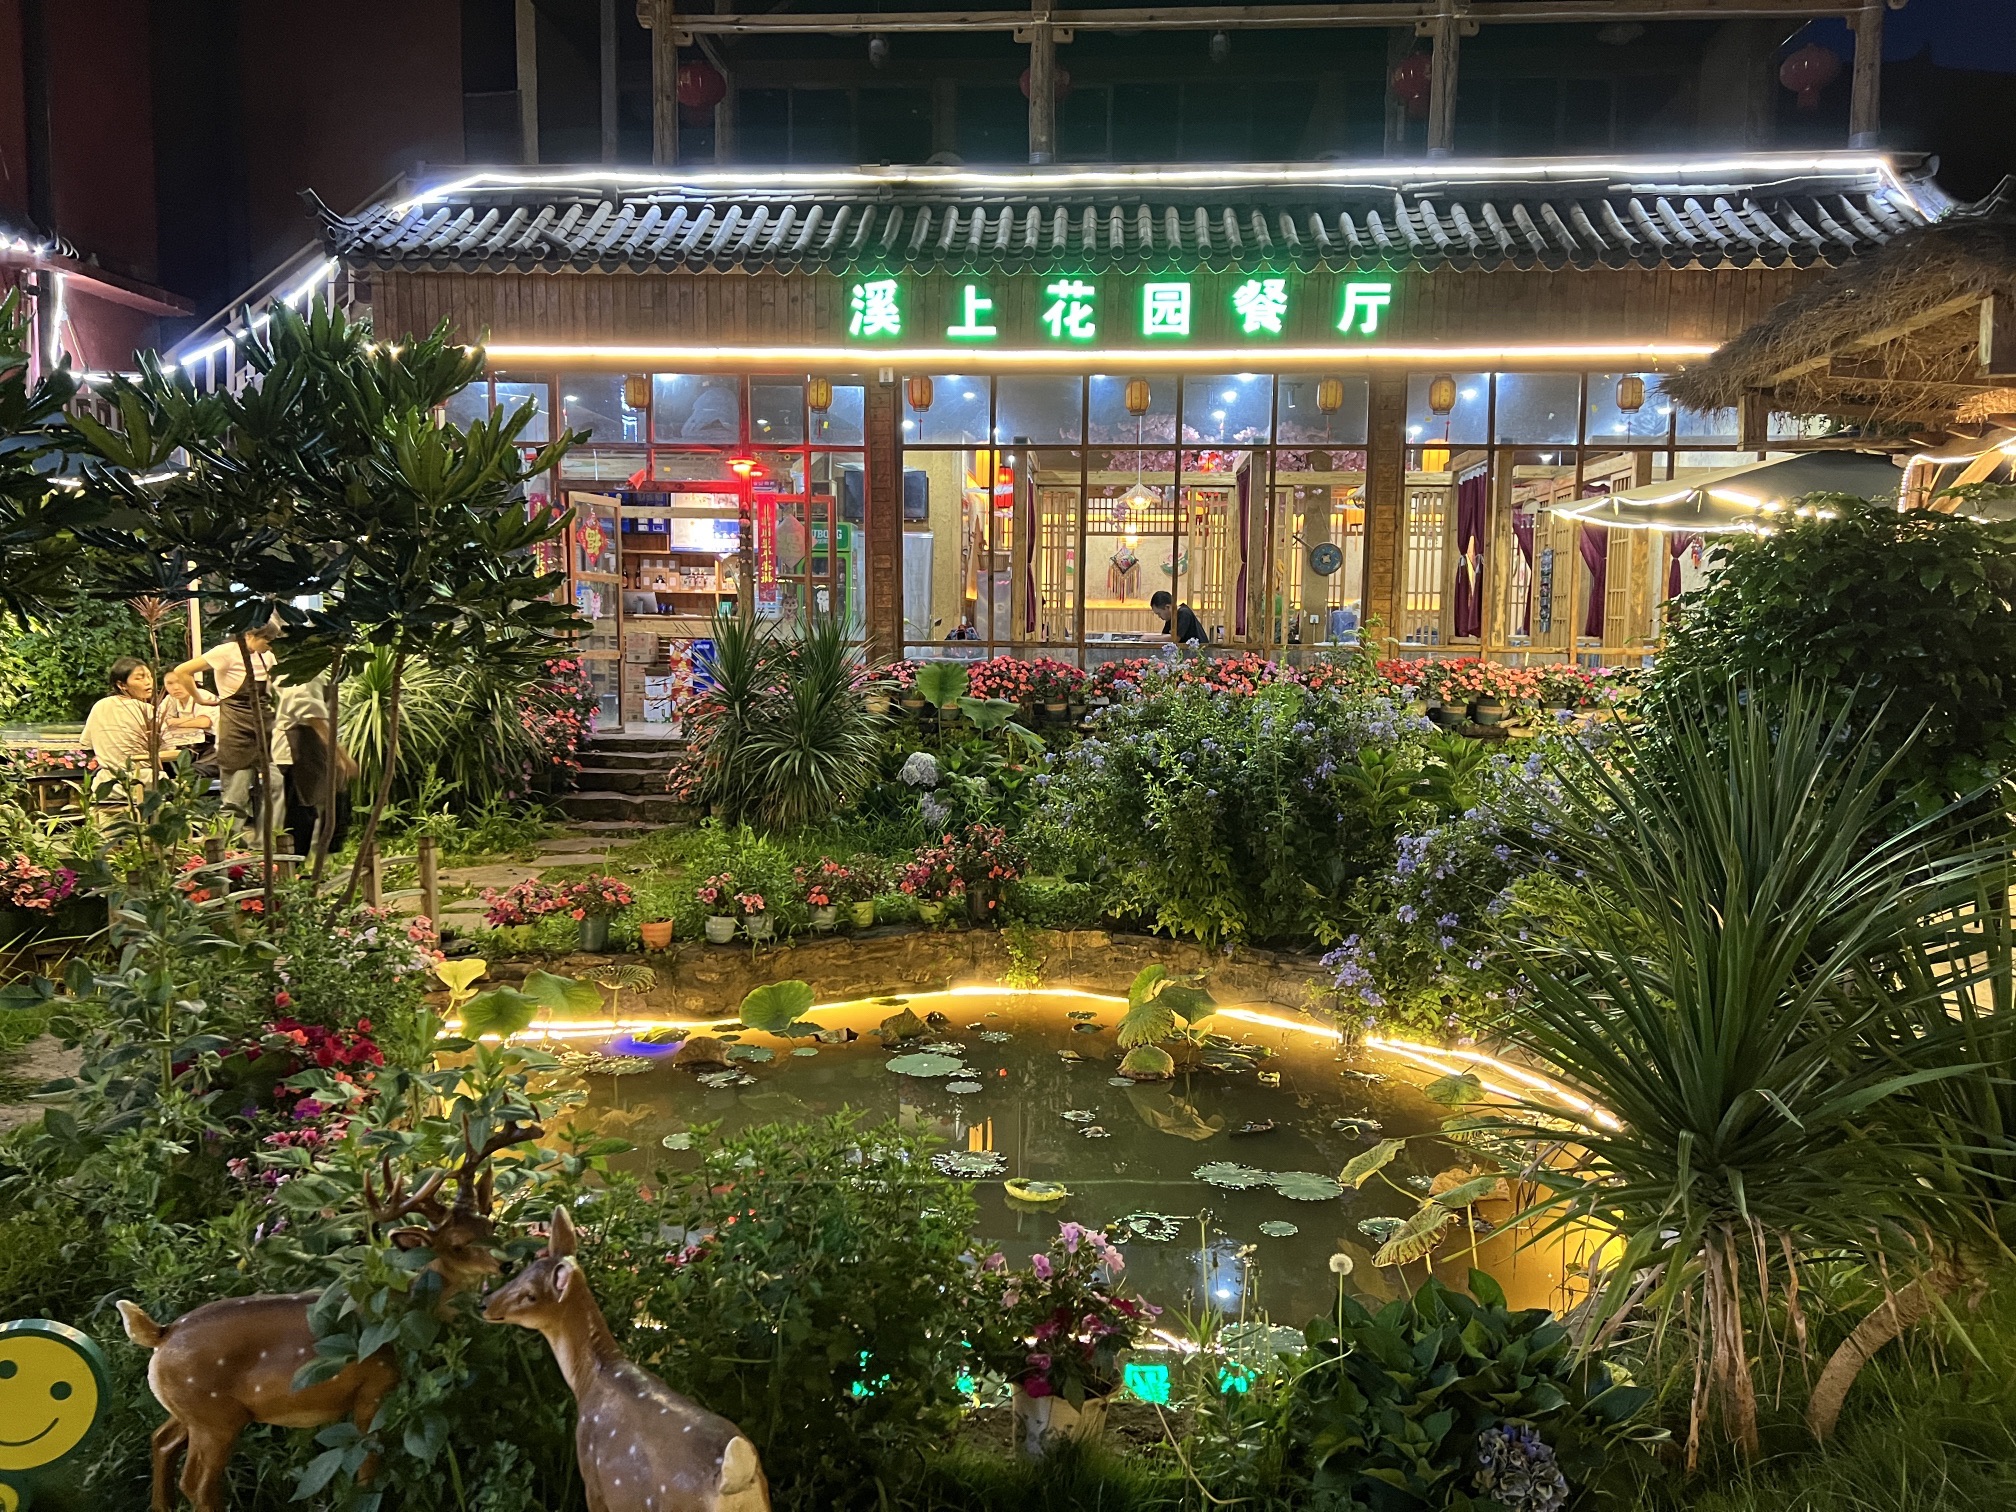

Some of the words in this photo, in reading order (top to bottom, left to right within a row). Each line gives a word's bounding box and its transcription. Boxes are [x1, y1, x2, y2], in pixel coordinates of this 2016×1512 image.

[849, 279, 1391, 337] 溪上花园餐厅
